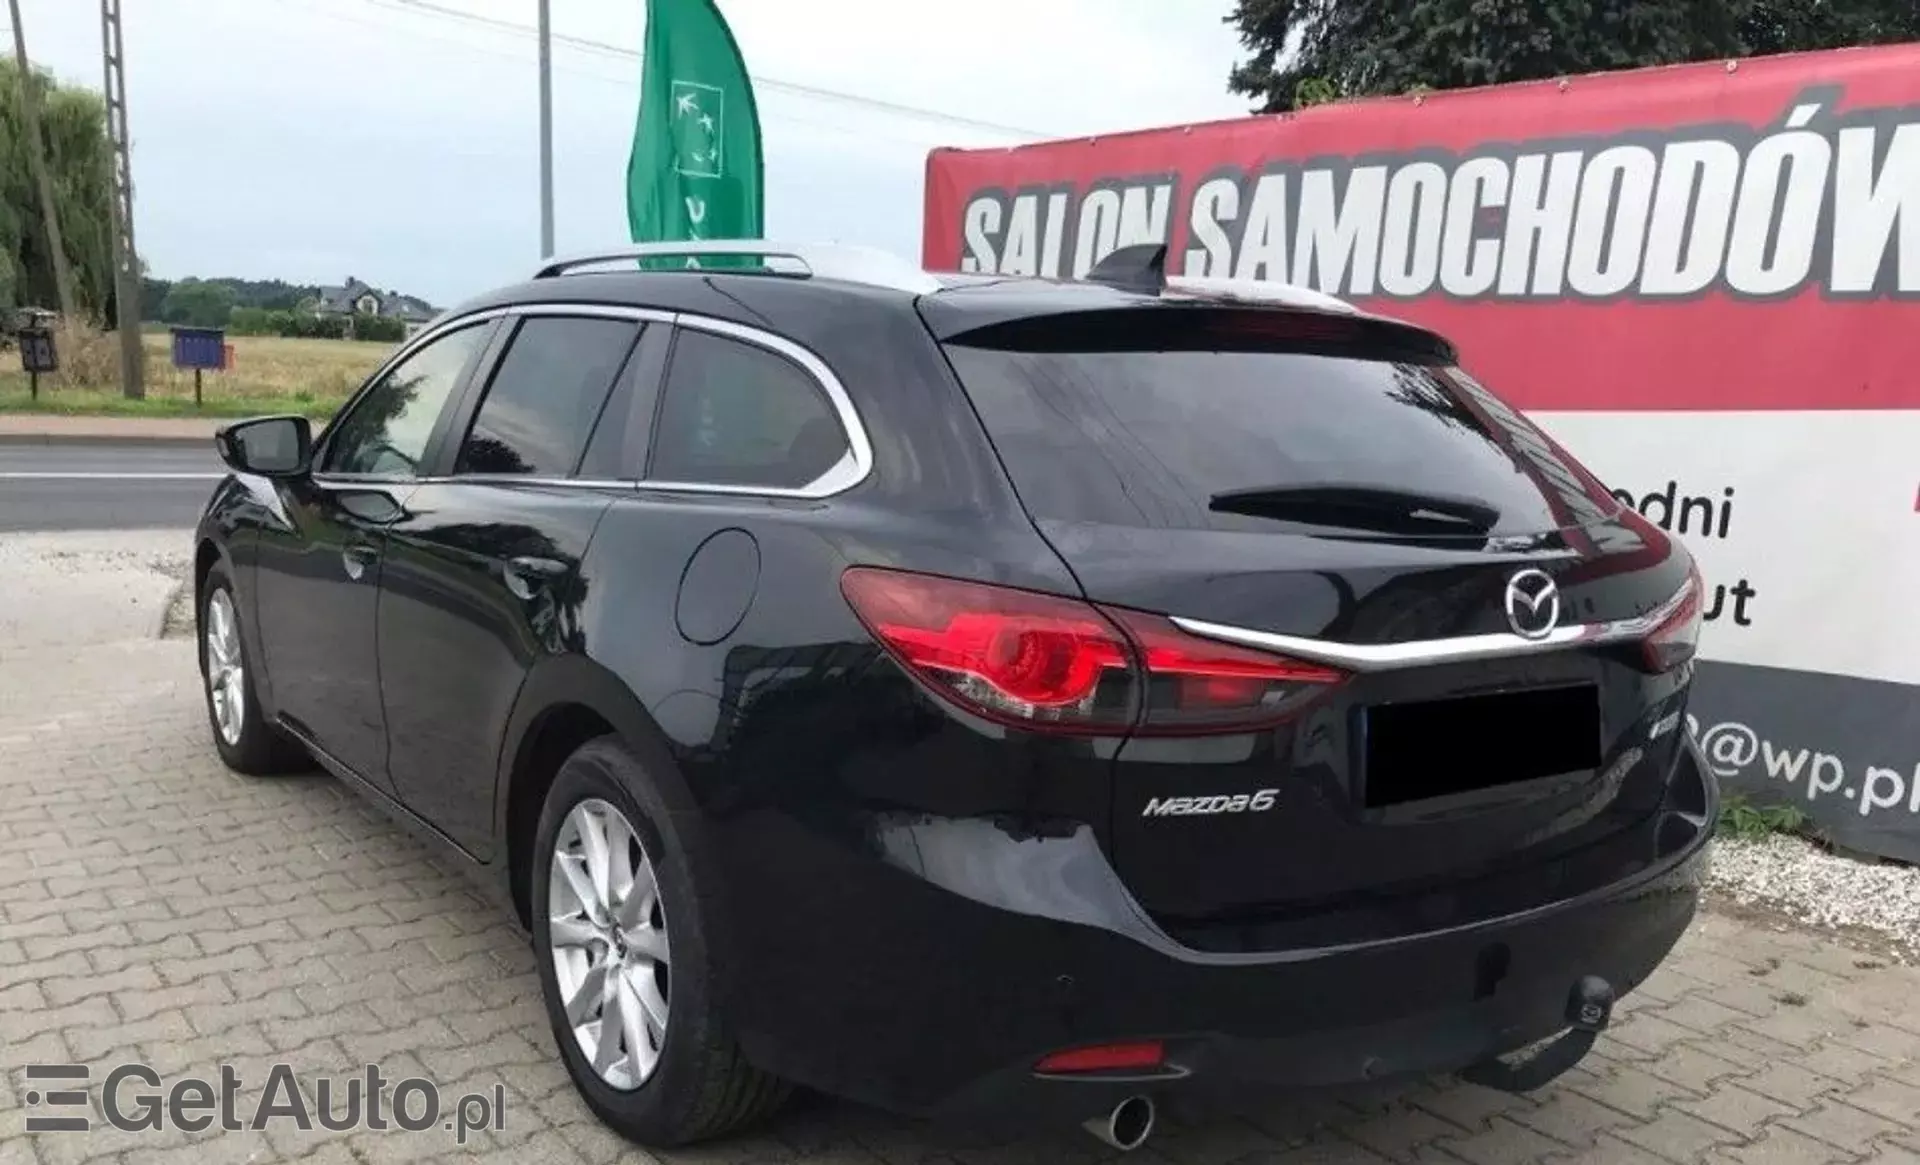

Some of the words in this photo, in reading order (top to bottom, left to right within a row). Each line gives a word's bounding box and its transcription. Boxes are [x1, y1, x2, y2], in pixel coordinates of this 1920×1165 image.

[961, 185, 1172, 281] SALON
[1184, 103, 1920, 296] SAMOCHODÓW
[1687, 713, 1920, 816] @wp.pl
